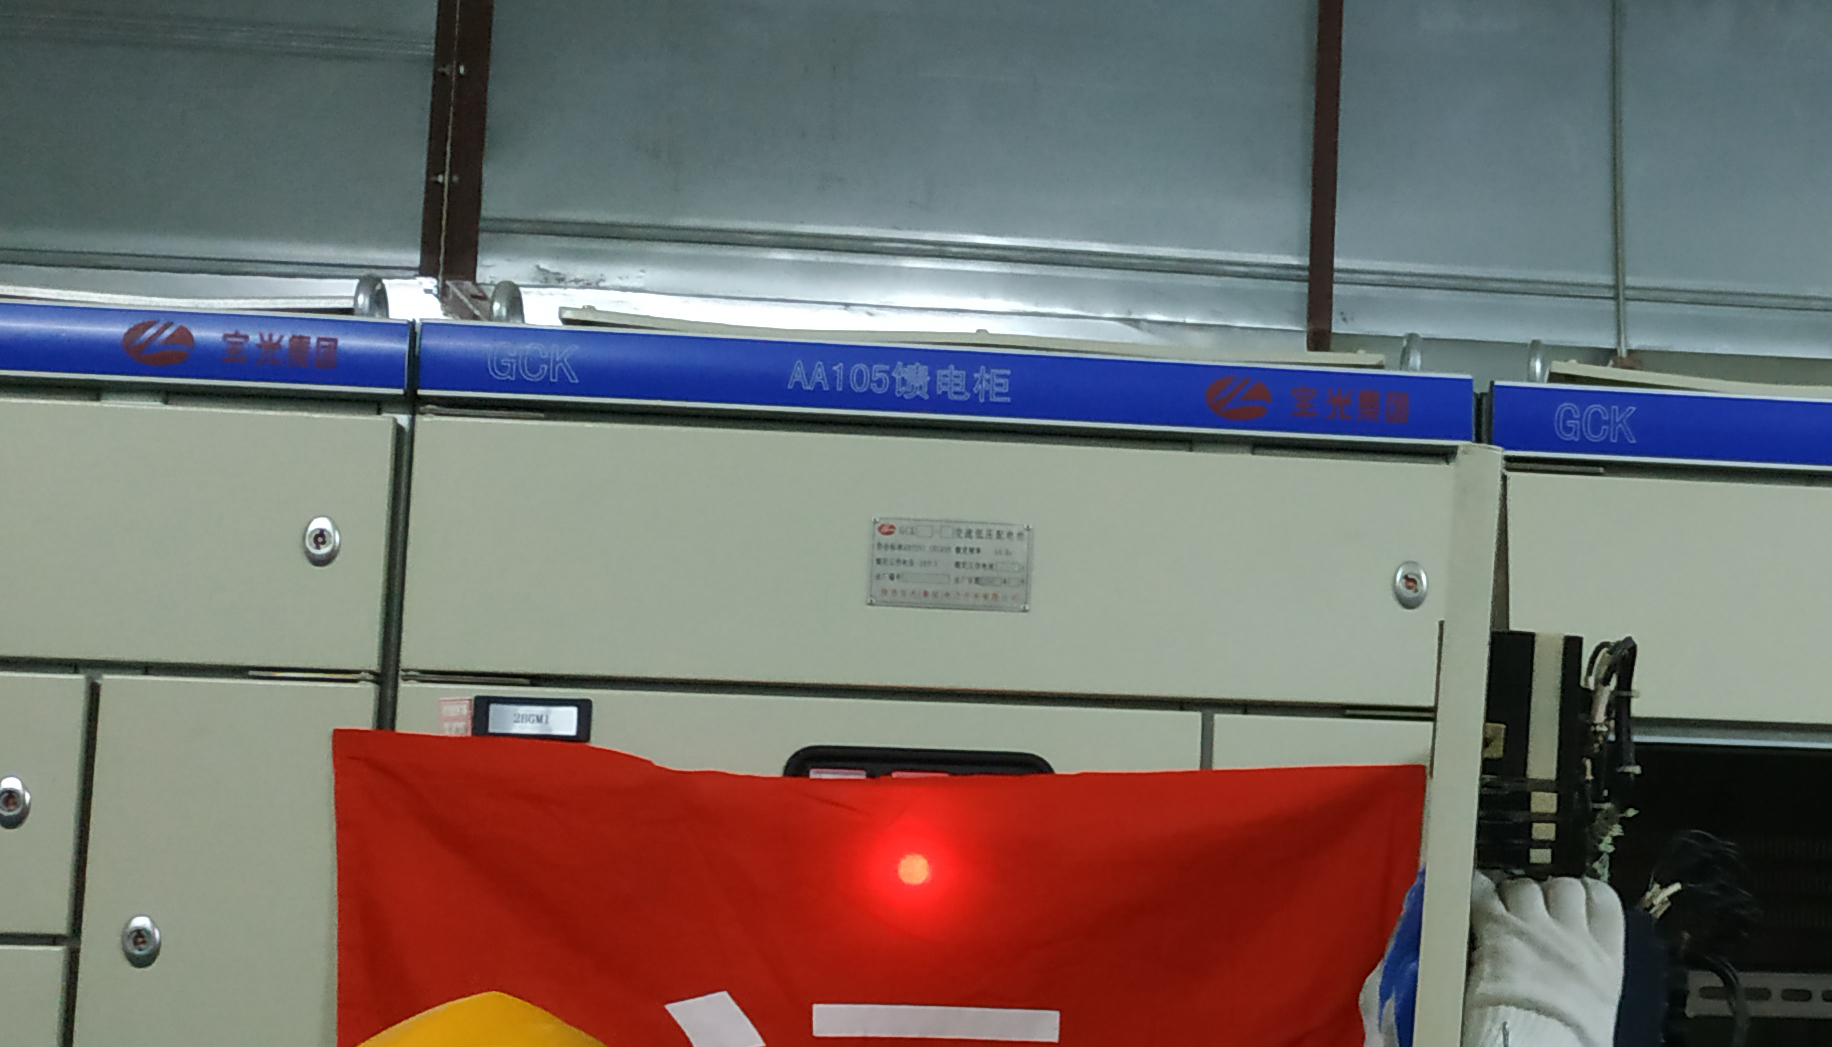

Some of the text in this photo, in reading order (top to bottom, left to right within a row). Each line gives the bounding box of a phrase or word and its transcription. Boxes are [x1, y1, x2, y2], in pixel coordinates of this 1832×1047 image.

[222, 330, 338, 371] 宝光集团
[487, 341, 579, 384] GCK
[787, 360, 1012, 403] AA105馈电柜
[1290, 386, 1410, 425] 宝光集团
[1554, 402, 1637, 444] GCK
